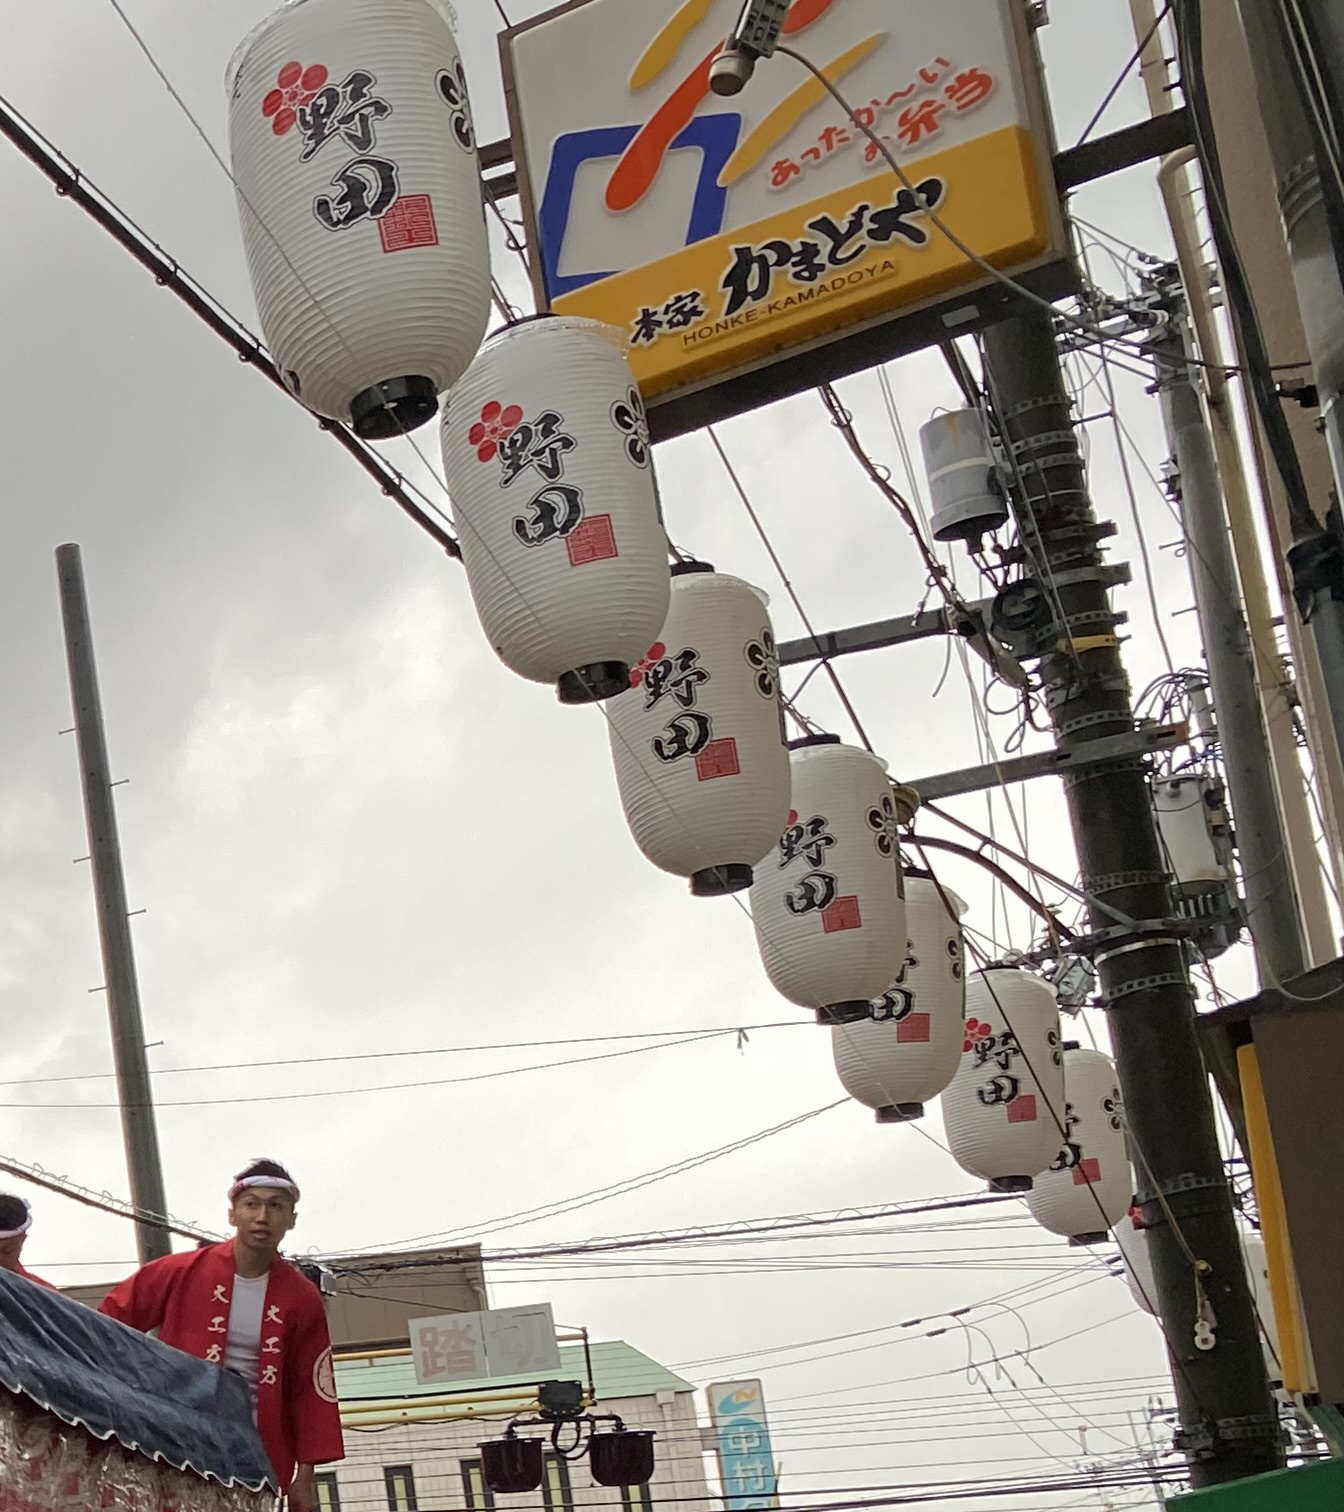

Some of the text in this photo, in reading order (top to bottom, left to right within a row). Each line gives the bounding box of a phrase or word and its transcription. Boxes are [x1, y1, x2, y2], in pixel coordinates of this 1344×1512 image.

[296, 69, 401, 233] 野田
[864, 67, 995, 163] お弁当
[631, 179, 945, 346] 本家 かまどや
[683, 260, 896, 346] HONKE-KAMADOYA
[499, 409, 585, 547] 野田
[644, 646, 711, 763] 野田
[779, 814, 836, 916] 野田
[973, 1031, 1020, 1107] 野田
[205, 1284, 230, 1365] 大工方
[258, 1303, 284, 1386] 大工方
[418, 1312, 548, 1378] 踏切
